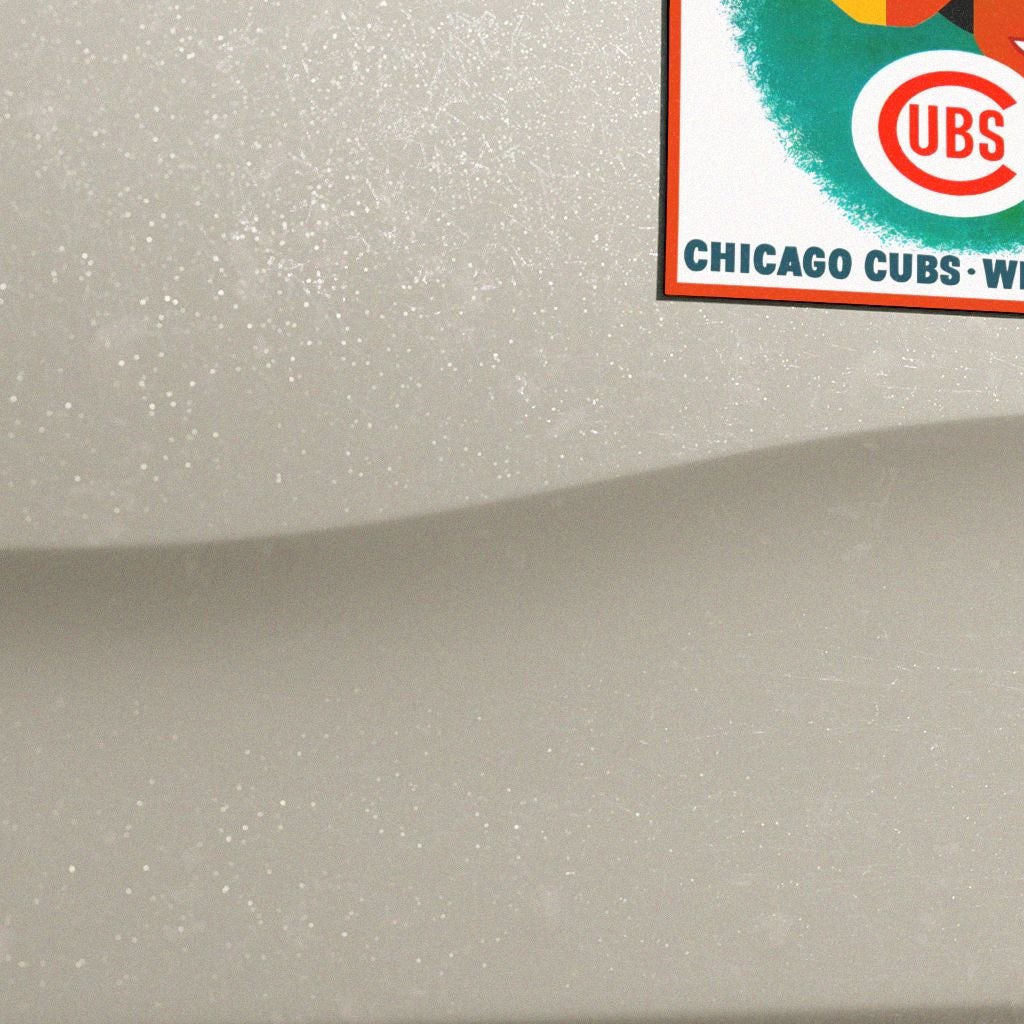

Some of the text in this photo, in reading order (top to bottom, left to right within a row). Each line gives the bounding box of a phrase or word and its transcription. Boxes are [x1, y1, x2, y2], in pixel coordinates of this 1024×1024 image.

[878, 71, 1017, 196] CUBS
[683, 238, 852, 280] CHICAGO
[864, 249, 961, 286] CUBS
